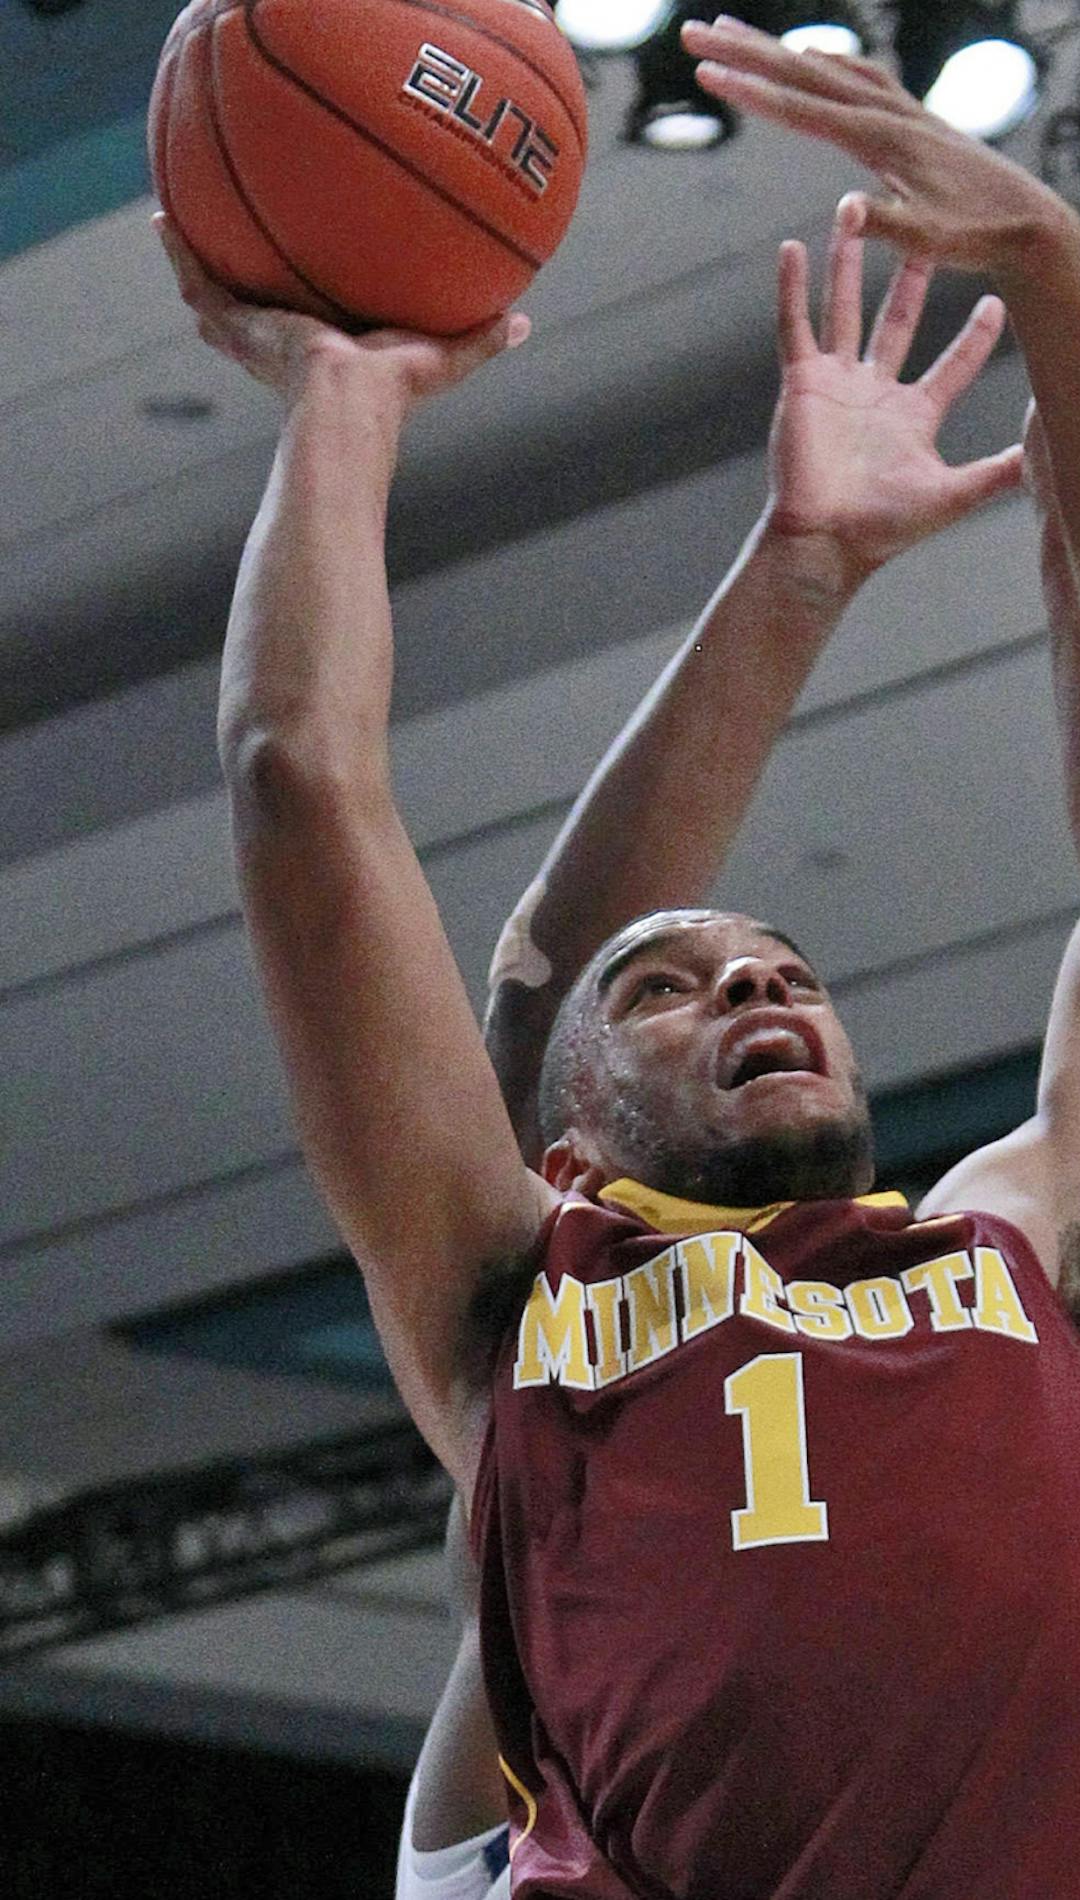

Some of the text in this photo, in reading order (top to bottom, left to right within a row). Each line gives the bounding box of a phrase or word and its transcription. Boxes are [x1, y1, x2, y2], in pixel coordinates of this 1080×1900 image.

[401, 42, 560, 198] ELITE
[513, 1231, 1039, 1391] MINNESOTA
[724, 1351, 829, 1552] 1
